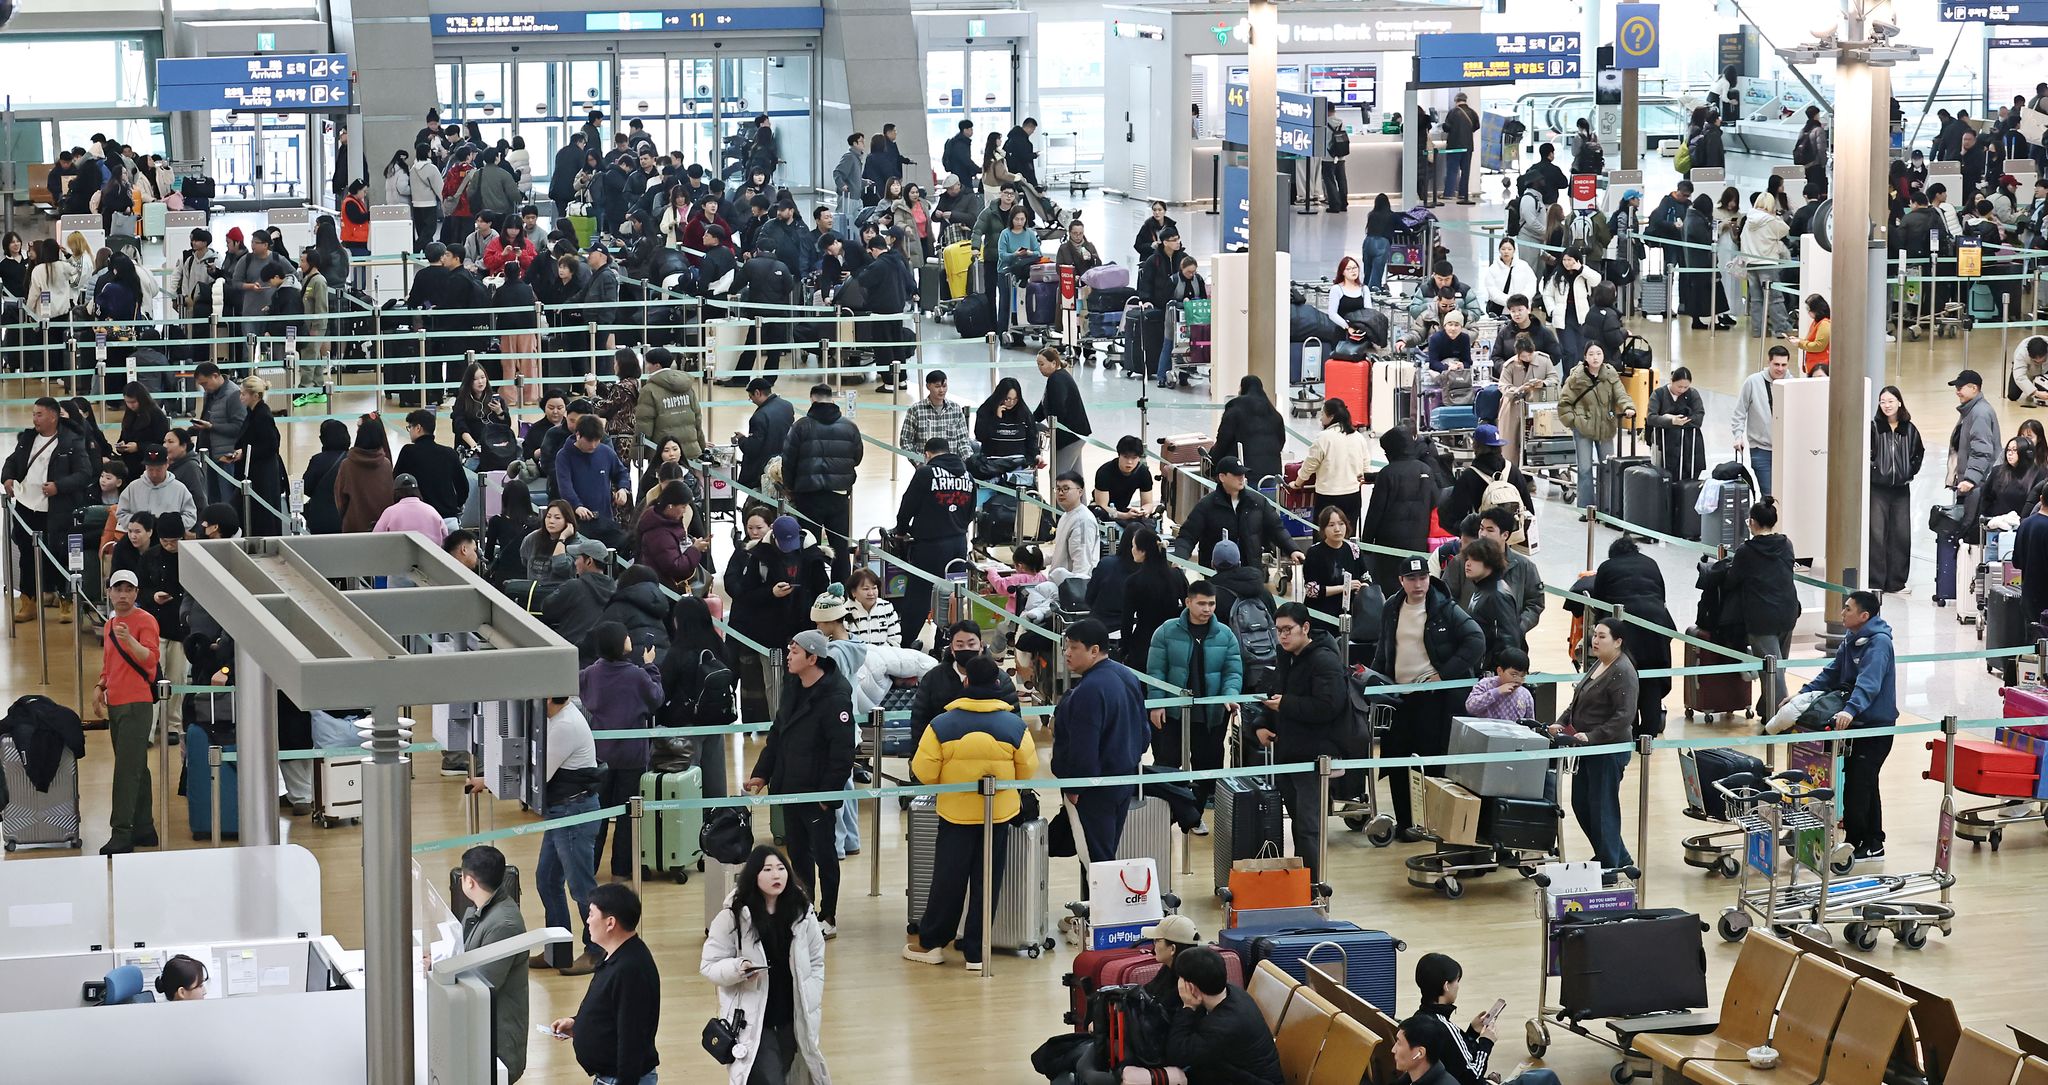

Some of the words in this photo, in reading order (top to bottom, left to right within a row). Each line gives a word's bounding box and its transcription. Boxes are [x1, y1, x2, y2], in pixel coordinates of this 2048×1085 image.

[690, 12, 704, 27] 11
[1293, 25, 1332, 41] Hana
[1333, 23, 1372, 41] Bank
[240, 97, 271, 107] Parking
[1228, 87, 1244, 107] 4-6
